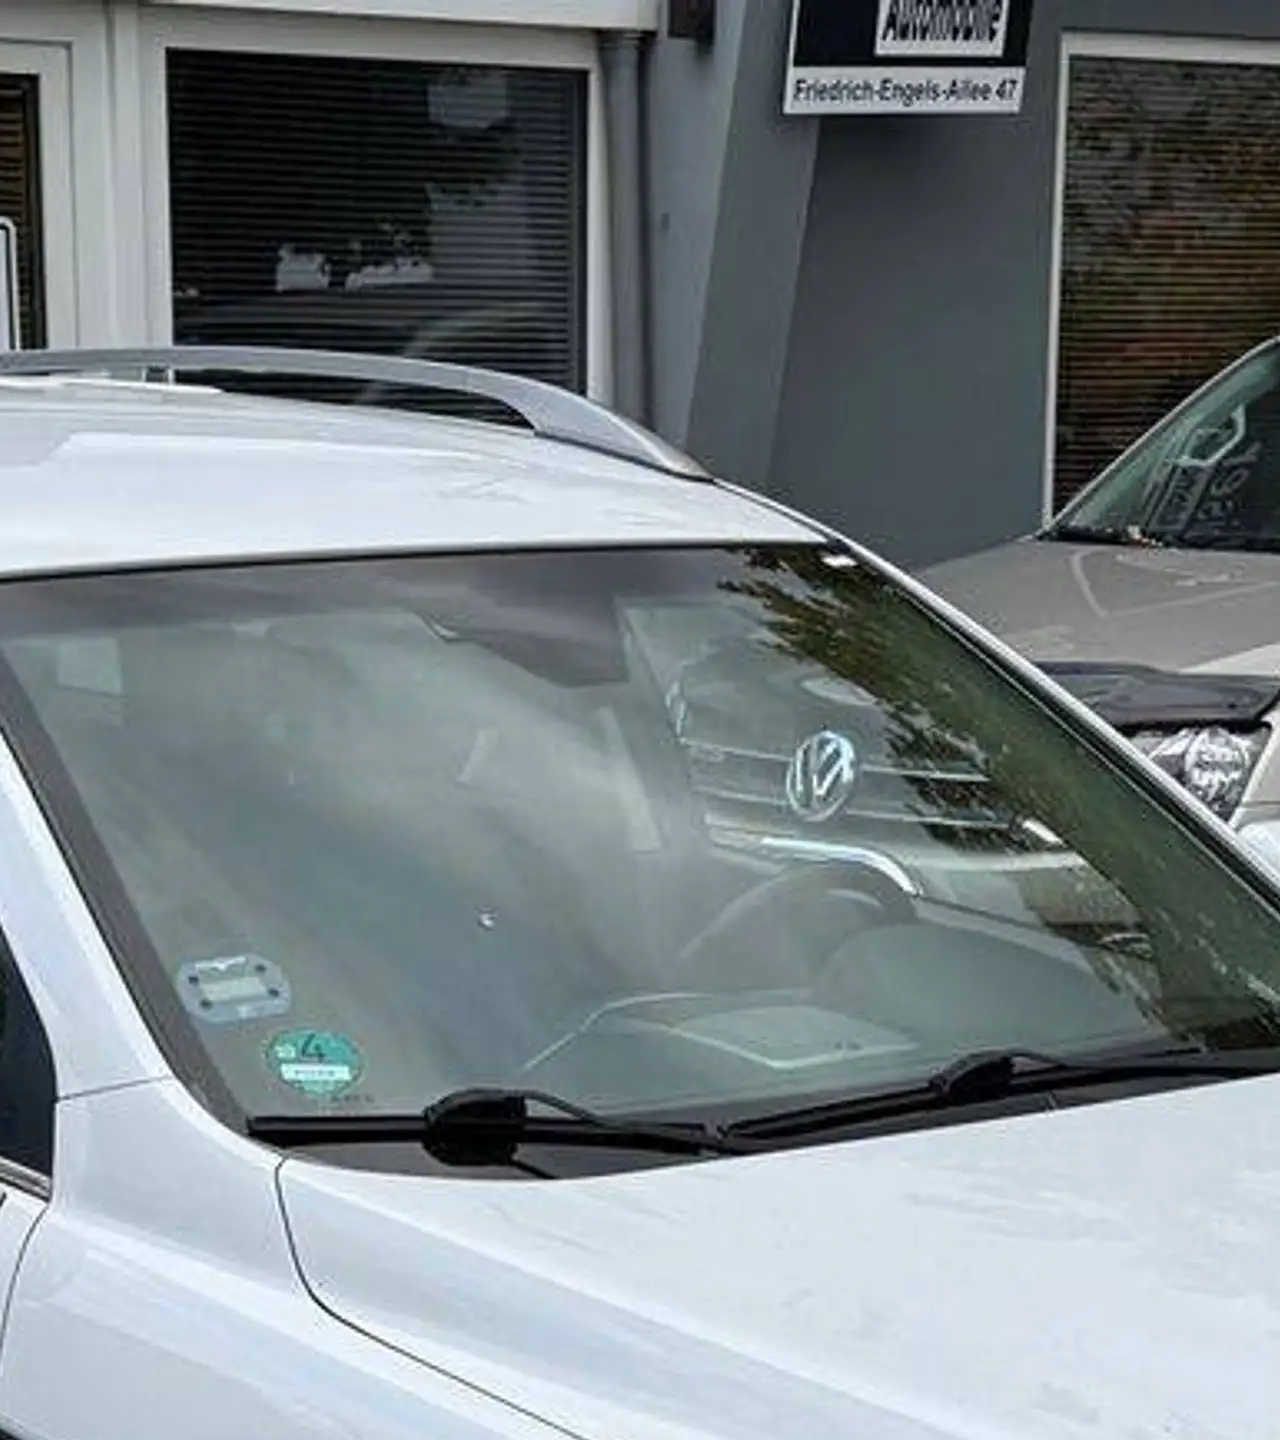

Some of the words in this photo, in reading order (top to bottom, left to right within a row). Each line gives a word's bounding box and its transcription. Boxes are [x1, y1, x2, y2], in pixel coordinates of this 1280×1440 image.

[794, 79, 991, 107] Friedrich-Engels-Allee
[995, 79, 1018, 99] 47
[301, 1033, 325, 1063] 4
